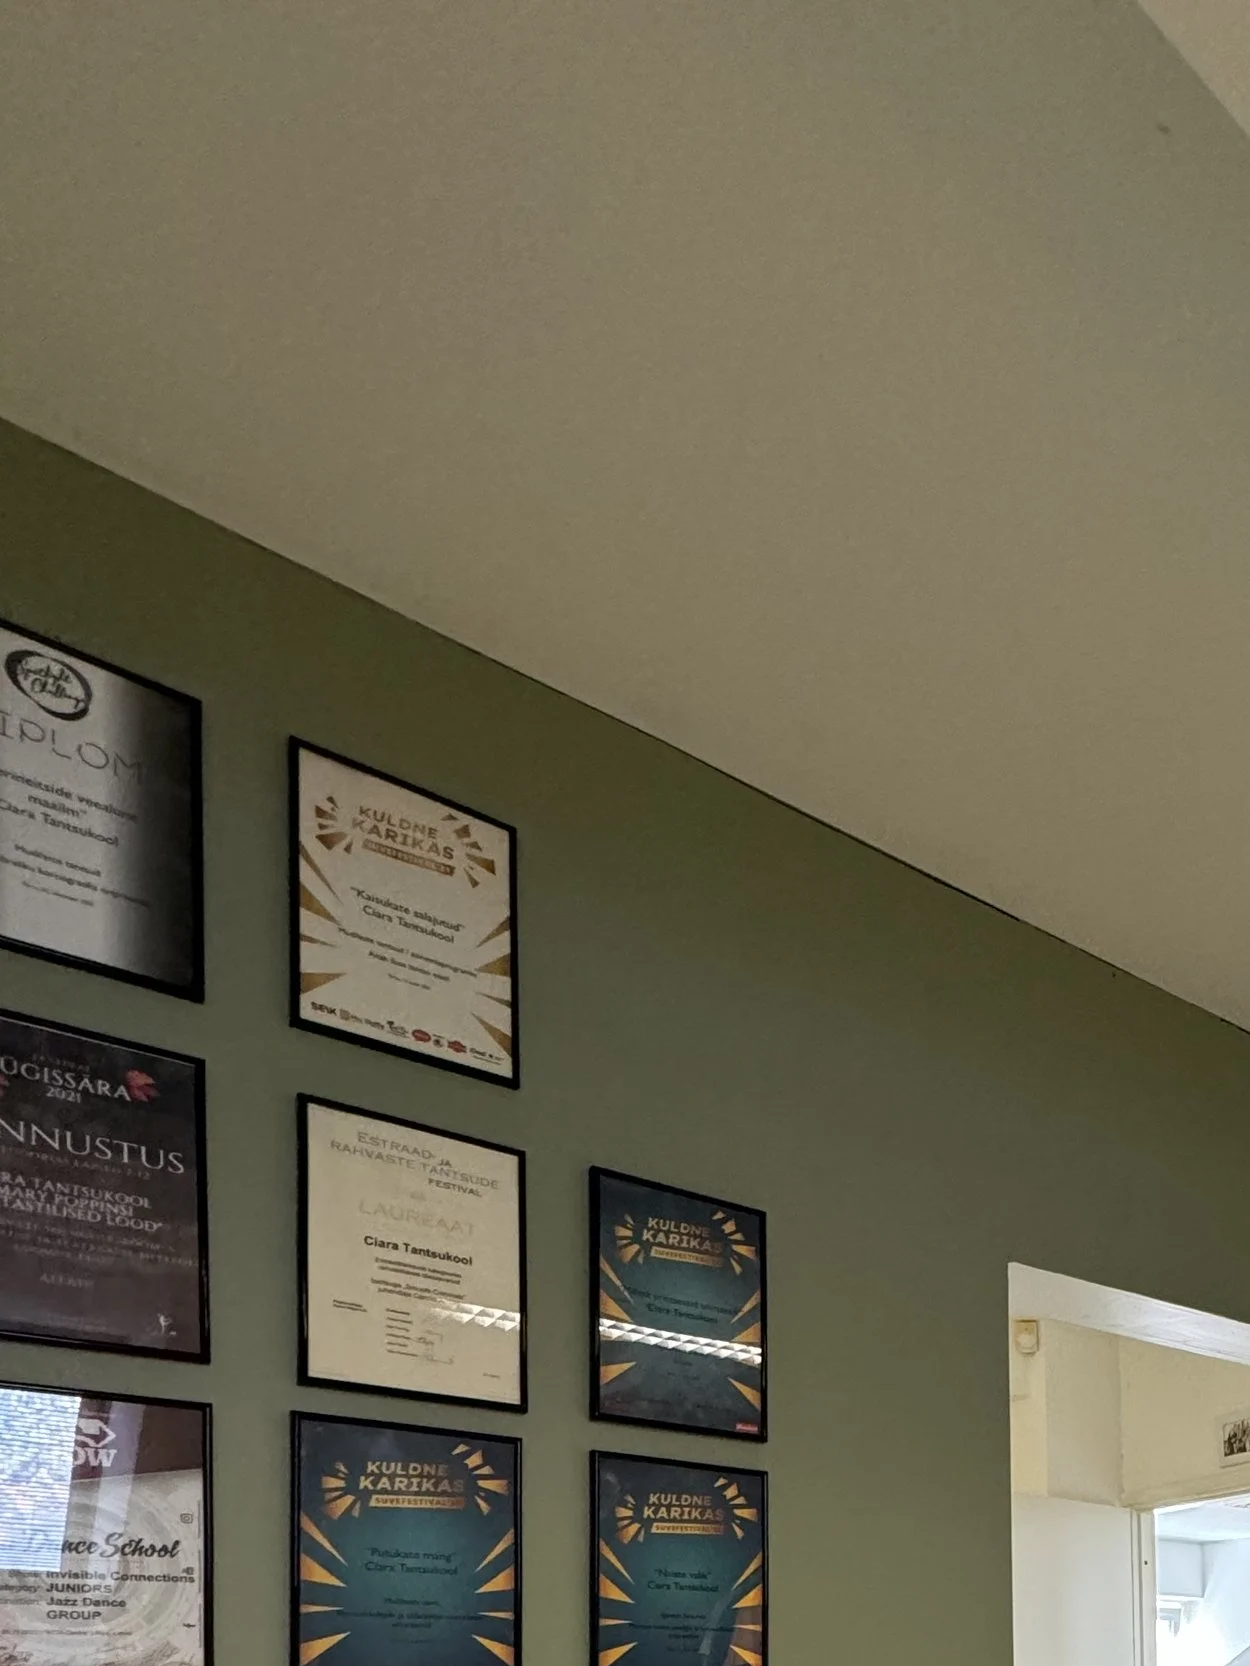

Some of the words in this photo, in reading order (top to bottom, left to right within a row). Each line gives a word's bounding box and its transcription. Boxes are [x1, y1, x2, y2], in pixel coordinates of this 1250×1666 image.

[0, 710, 142, 786] IPLOM
[359, 805, 438, 839] KULDNE
[352, 818, 454, 860] KARIKAS
[0, 1118, 185, 1174] NNUSTUS
[330, 1139, 416, 1169] RAHVASTE
[420, 1162, 499, 1190] TANTSUDE
[0, 1171, 26, 1187] RA
[31, 1176, 152, 1209] TANTSUKOOL
[428, 1177, 482, 1197] FESTIVAL
[0, 1194, 101, 1223] TASTILISED
[648, 1217, 710, 1238] KULDNE
[402, 1242, 473, 1266] Tantsukool
[366, 1461, 449, 1477] KULDNE
[359, 1475, 465, 1493] KARIKAS
[648, 1492, 713, 1506] KULDNE
[643, 1505, 725, 1522] KARIKAS
[99, 1532, 180, 1558] School
[46, 1571, 107, 1581] Invisible
[110, 1571, 196, 1584] Connections
[46, 1583, 113, 1594] JUNIORS
[46, 1597, 78, 1607] Jazz
[82, 1598, 127, 1608] Dance
[46, 1610, 102, 1621] GROUP
